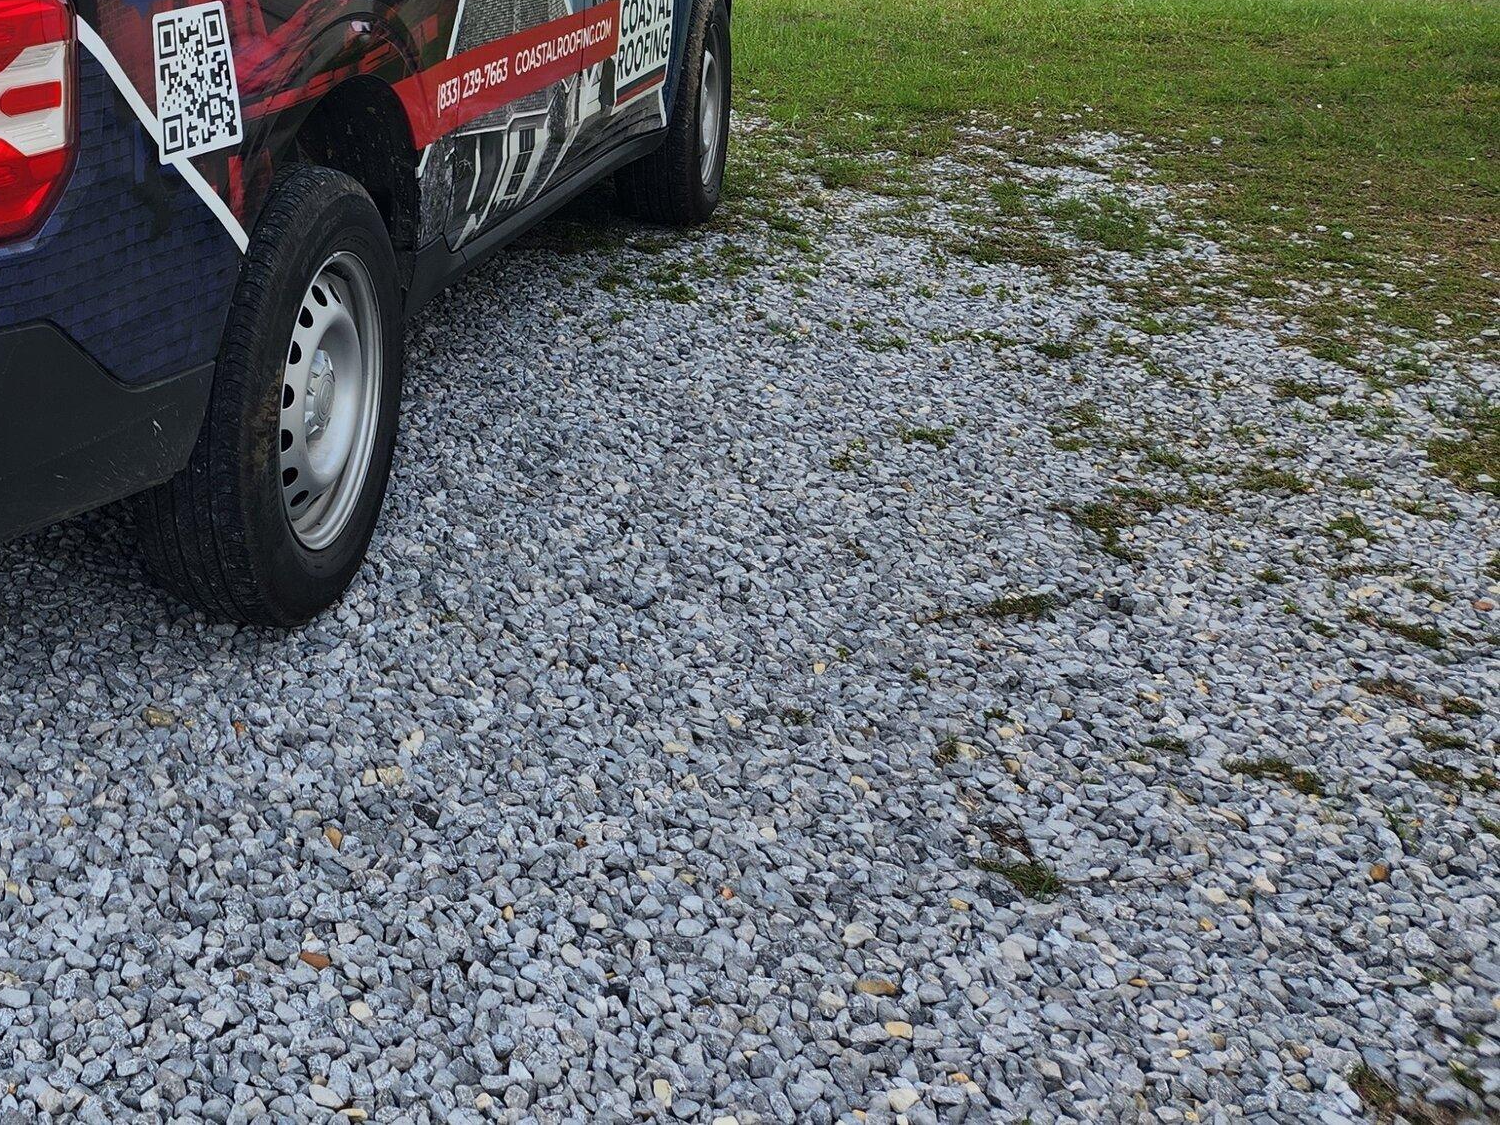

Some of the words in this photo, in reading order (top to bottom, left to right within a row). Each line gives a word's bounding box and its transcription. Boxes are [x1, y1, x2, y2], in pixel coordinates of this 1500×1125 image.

[437, 75, 461, 118] (833)
[462, 57, 509, 99] 239-7663
[514, 17, 613, 76] COASTALROOFING.COM
[617, 28, 671, 81] ROOFING
